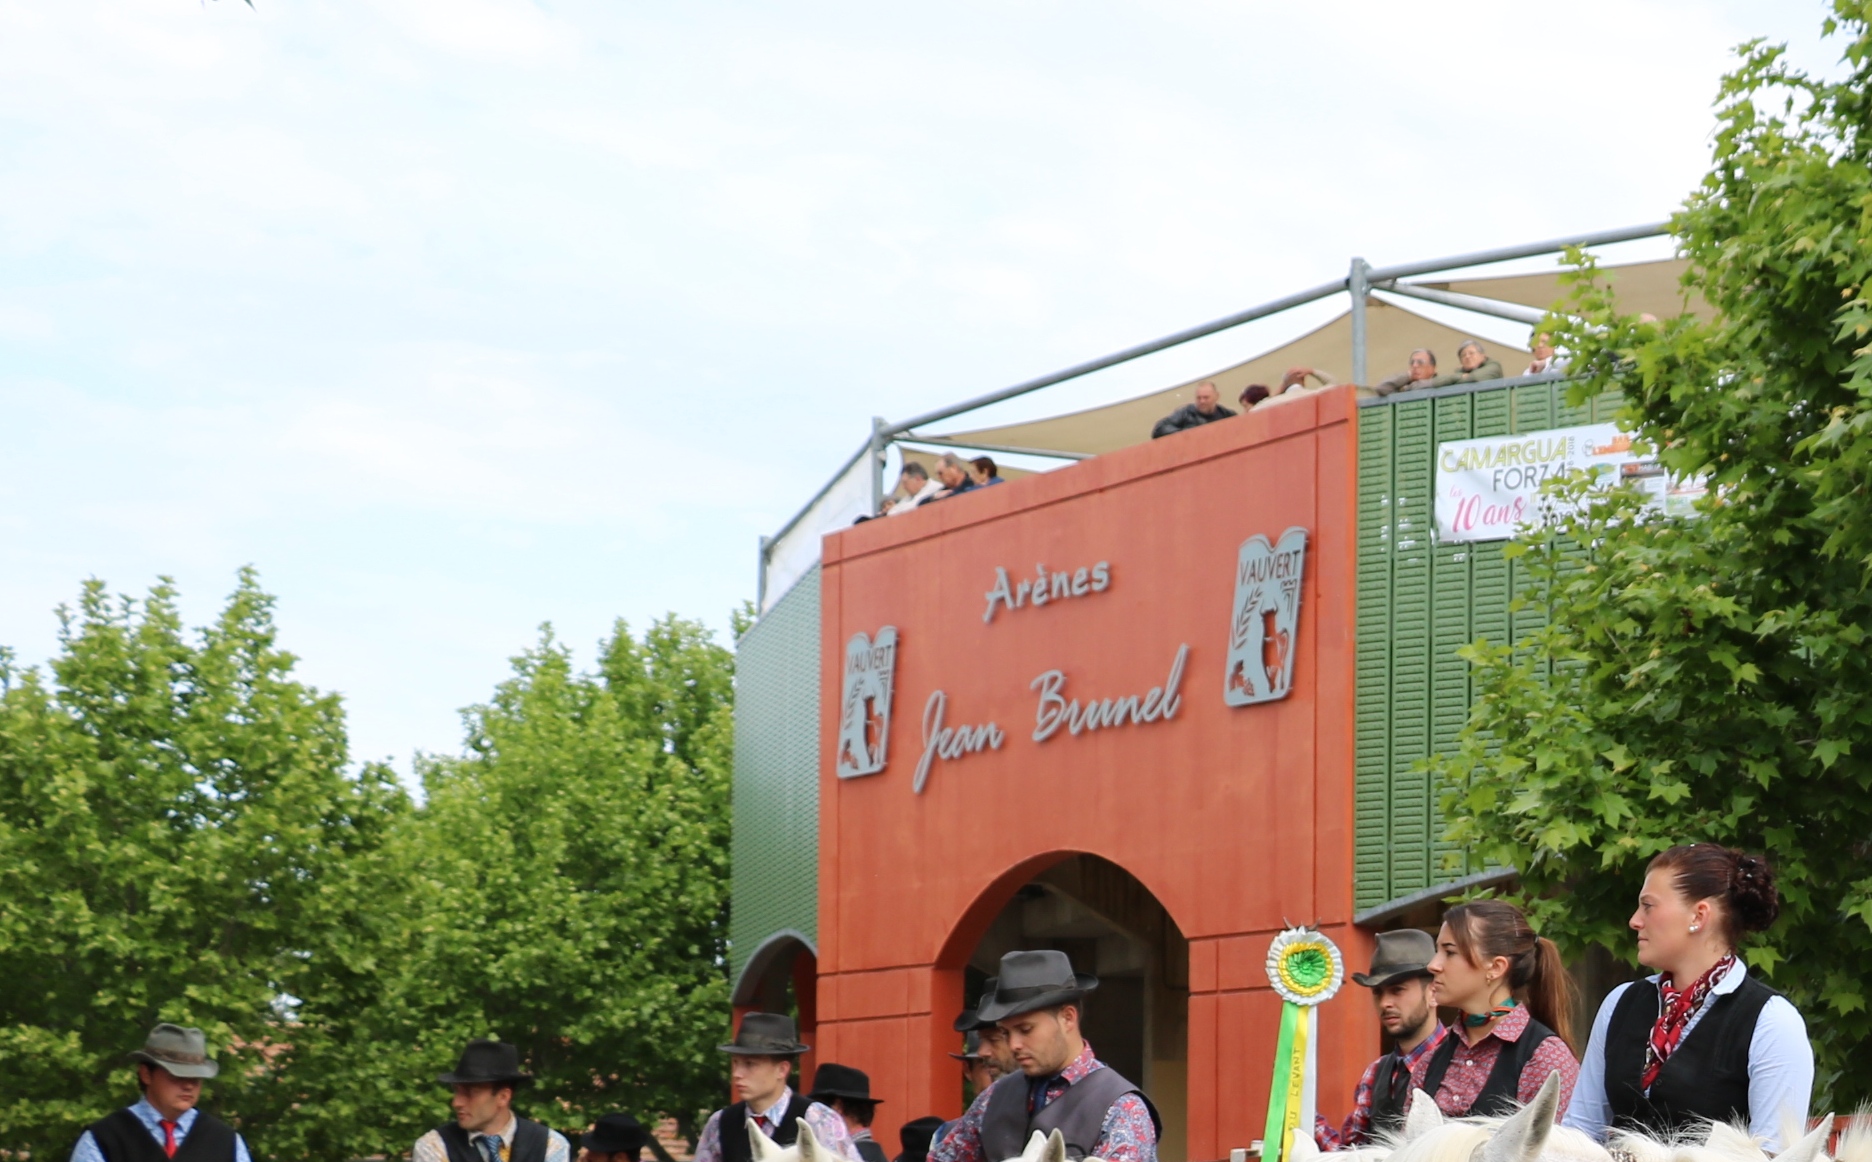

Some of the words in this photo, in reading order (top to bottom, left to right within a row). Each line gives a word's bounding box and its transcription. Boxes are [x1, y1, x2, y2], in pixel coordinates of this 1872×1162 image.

[1440, 436, 1568, 473] CAMARGUA
[1493, 463, 1567, 491] FORZA
[1452, 494, 1481, 533] 10
[1482, 496, 1527, 525] ans
[1239, 549, 1301, 586] VAUVERT
[981, 559, 1111, 622] Arènes
[847, 644, 892, 674] VAUVERT
[913, 690, 1004, 794] Jean
[1029, 643, 1191, 743] Brunel
[1290, 1047, 1301, 1097] LEVANT
